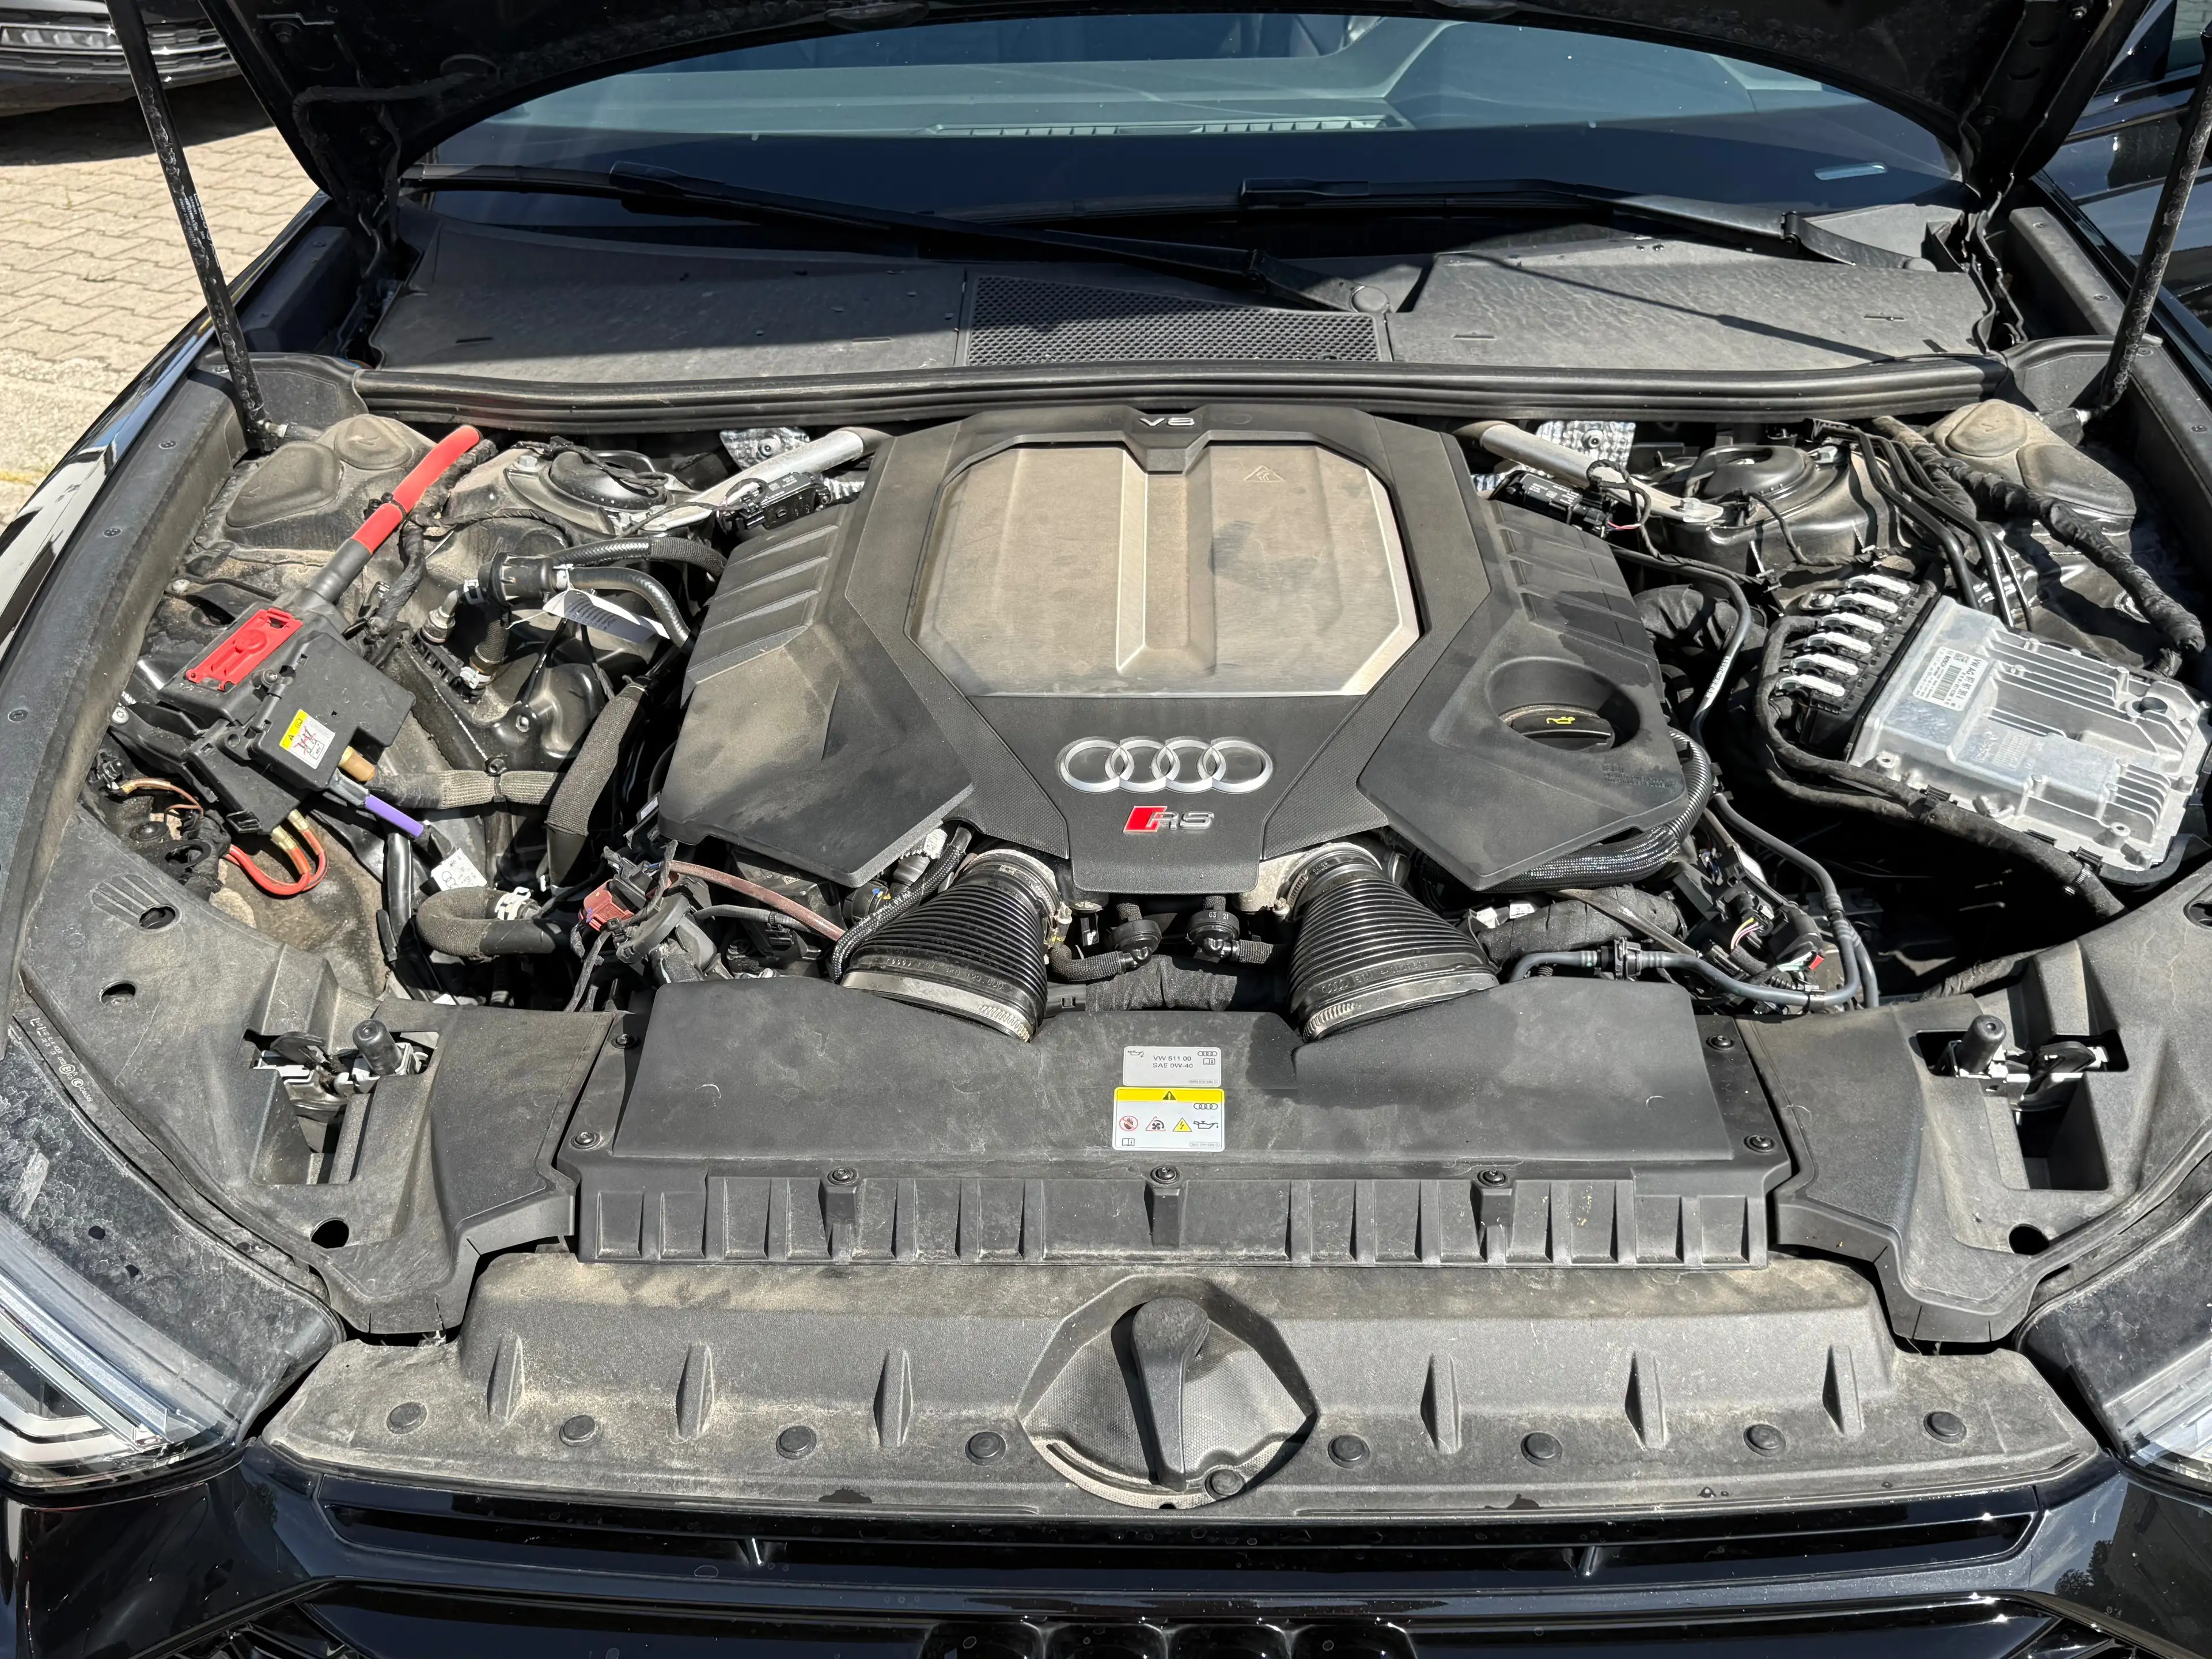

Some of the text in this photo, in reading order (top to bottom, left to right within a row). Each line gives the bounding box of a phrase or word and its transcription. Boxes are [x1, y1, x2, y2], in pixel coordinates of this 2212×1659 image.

[1139, 417, 1195, 426] V8
[1940, 655, 1951, 668] BOSCH
[1970, 658, 1982, 668] VW
[1965, 666, 1976, 676] AG
[1145, 810, 1215, 831] RS
